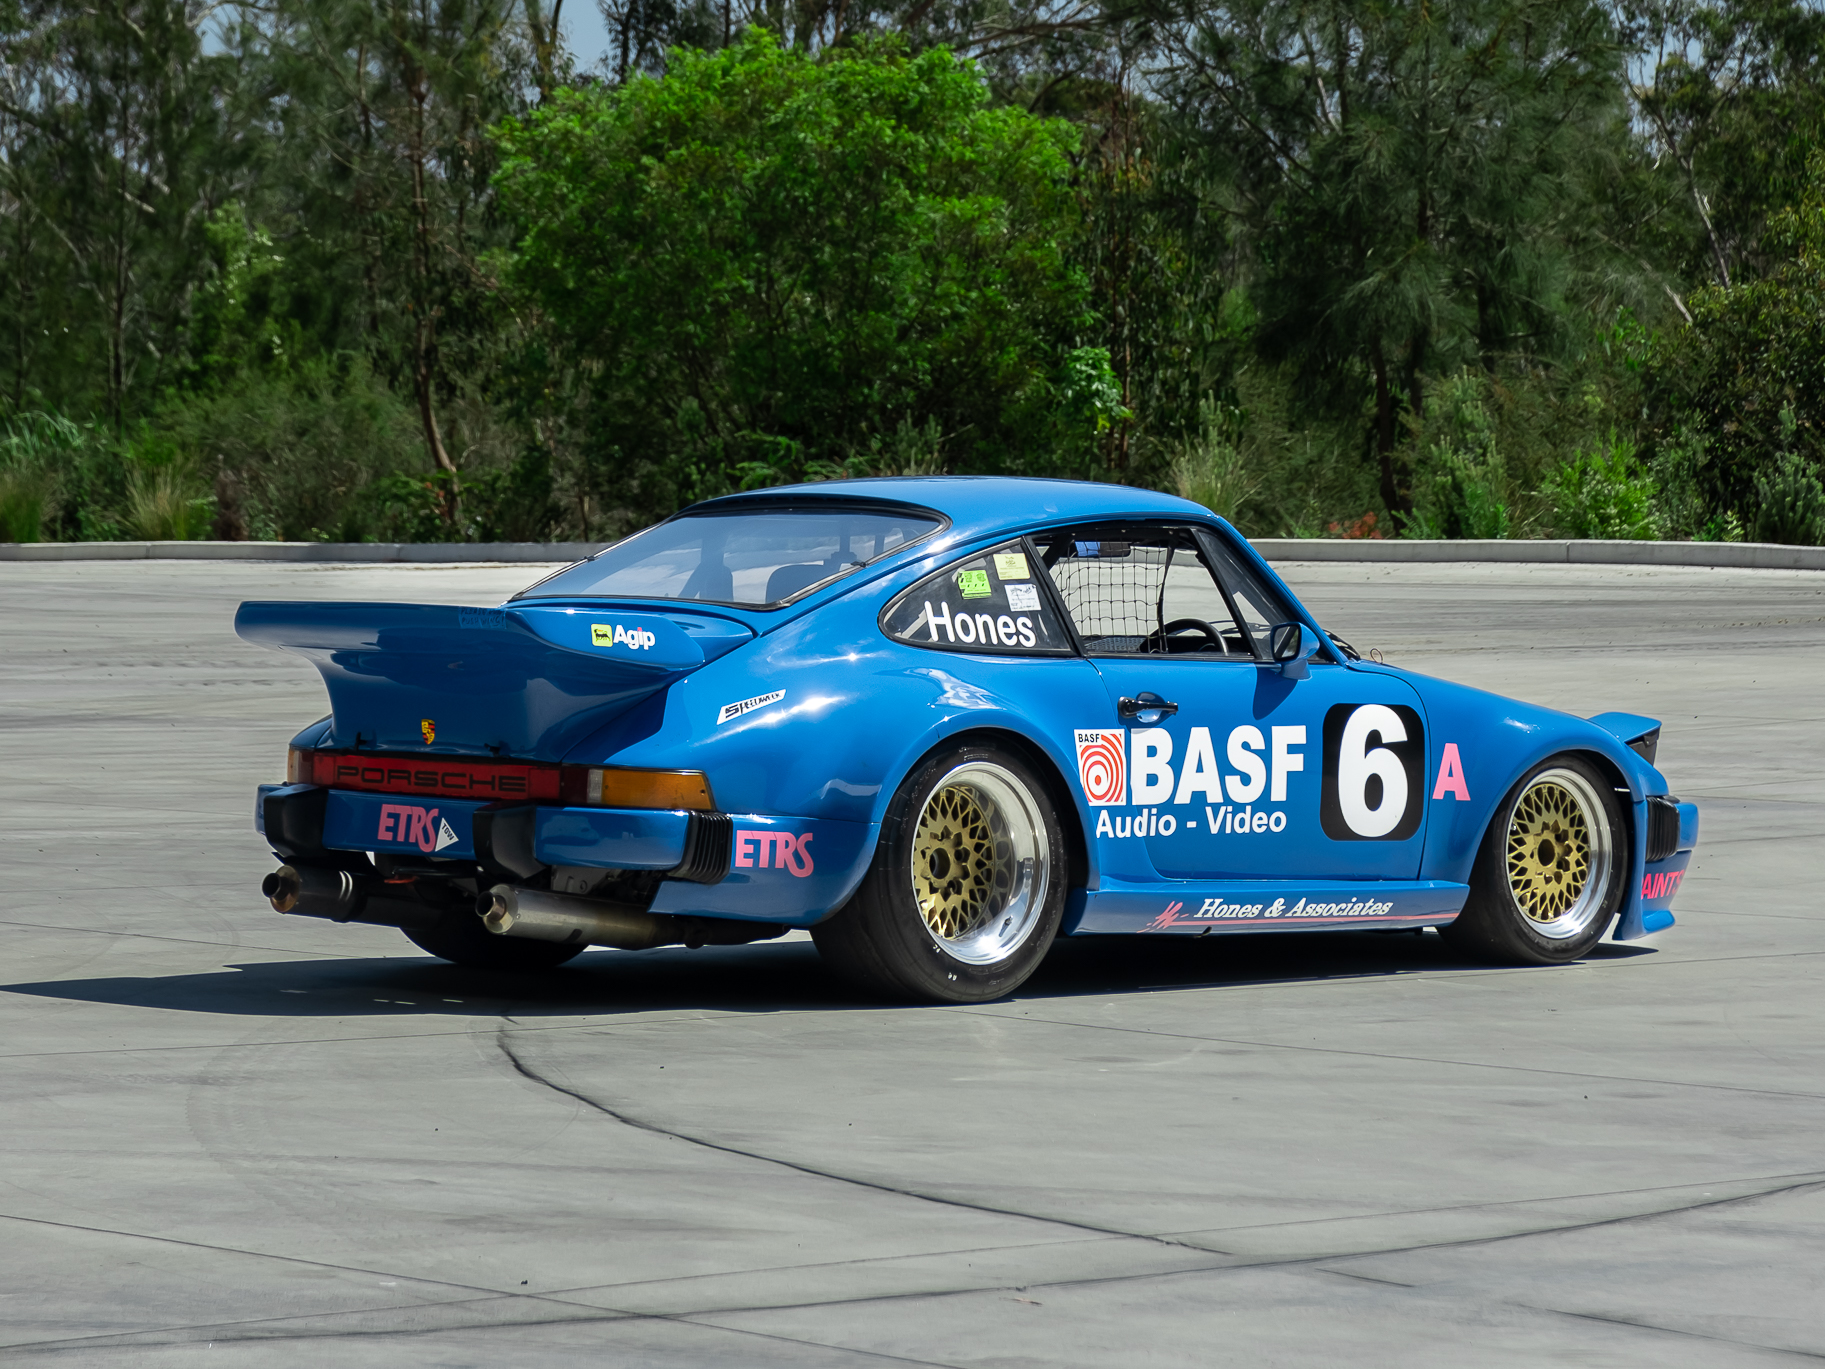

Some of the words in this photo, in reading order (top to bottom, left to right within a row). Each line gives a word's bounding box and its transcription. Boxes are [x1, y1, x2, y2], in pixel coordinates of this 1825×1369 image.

[613, 624, 656, 650] Agip
[924, 600, 1036, 648] Hones
[1078, 733, 1101, 743] BASF
[337, 765, 527, 793] PORSCHE
[1130, 725, 1307, 806] BASF
[1338, 704, 1408, 838] 6
[1432, 742, 1471, 801] A
[377, 803, 439, 853] ETRS
[441, 823, 455, 841] TOW
[1096, 808, 1177, 839] Audio
[1205, 805, 1287, 835] Video
[735, 830, 814, 878] ETRS
[1641, 869, 1685, 900] AINTS
[1194, 898, 1263, 918] Hones
[1264, 897, 1286, 918] &
[1285, 896, 1393, 918] Associates
